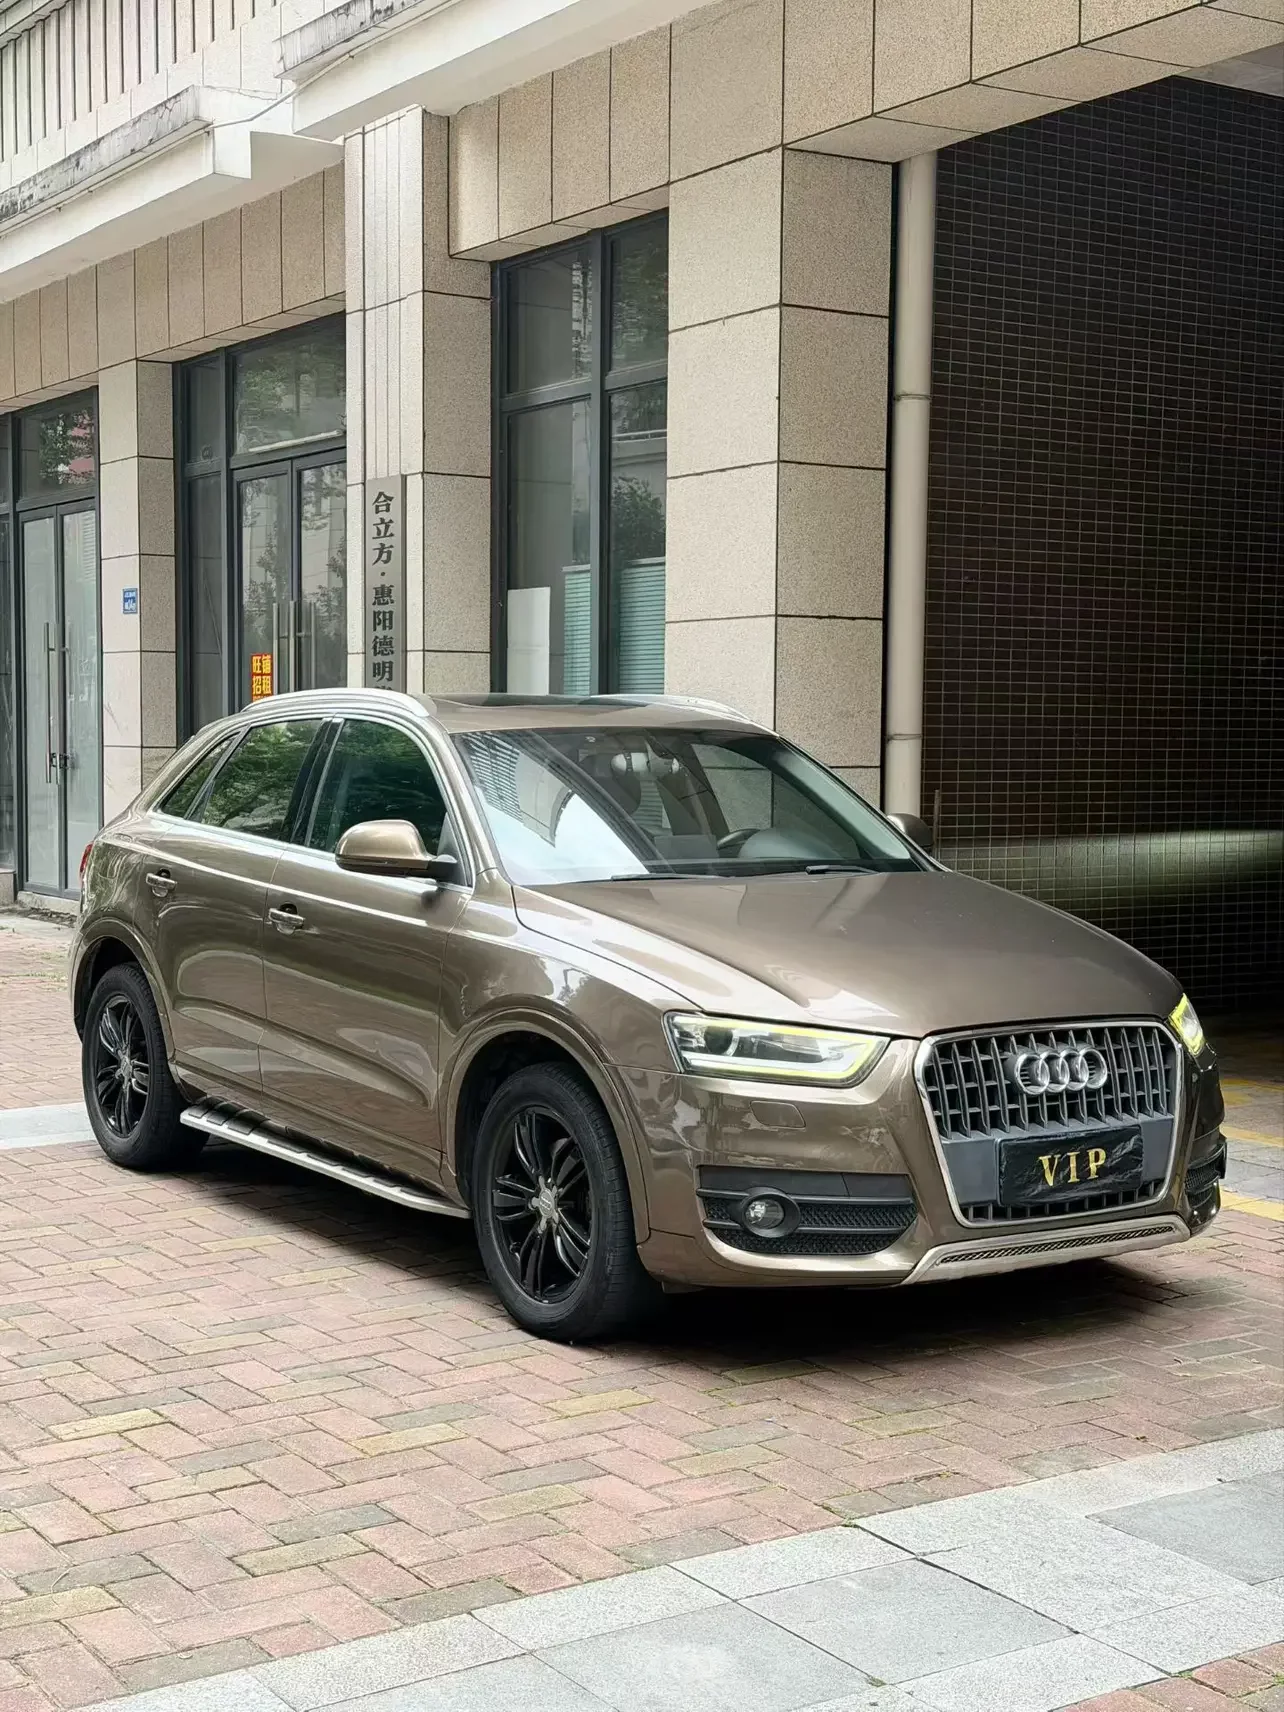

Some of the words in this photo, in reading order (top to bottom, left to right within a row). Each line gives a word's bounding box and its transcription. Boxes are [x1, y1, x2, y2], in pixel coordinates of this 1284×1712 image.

[372, 491, 394, 690] 合立方·惠阳德明
[252, 654, 272, 674] 旺铺
[252, 675, 272, 695] 招租
[1038, 1148, 1107, 1187] VIP
